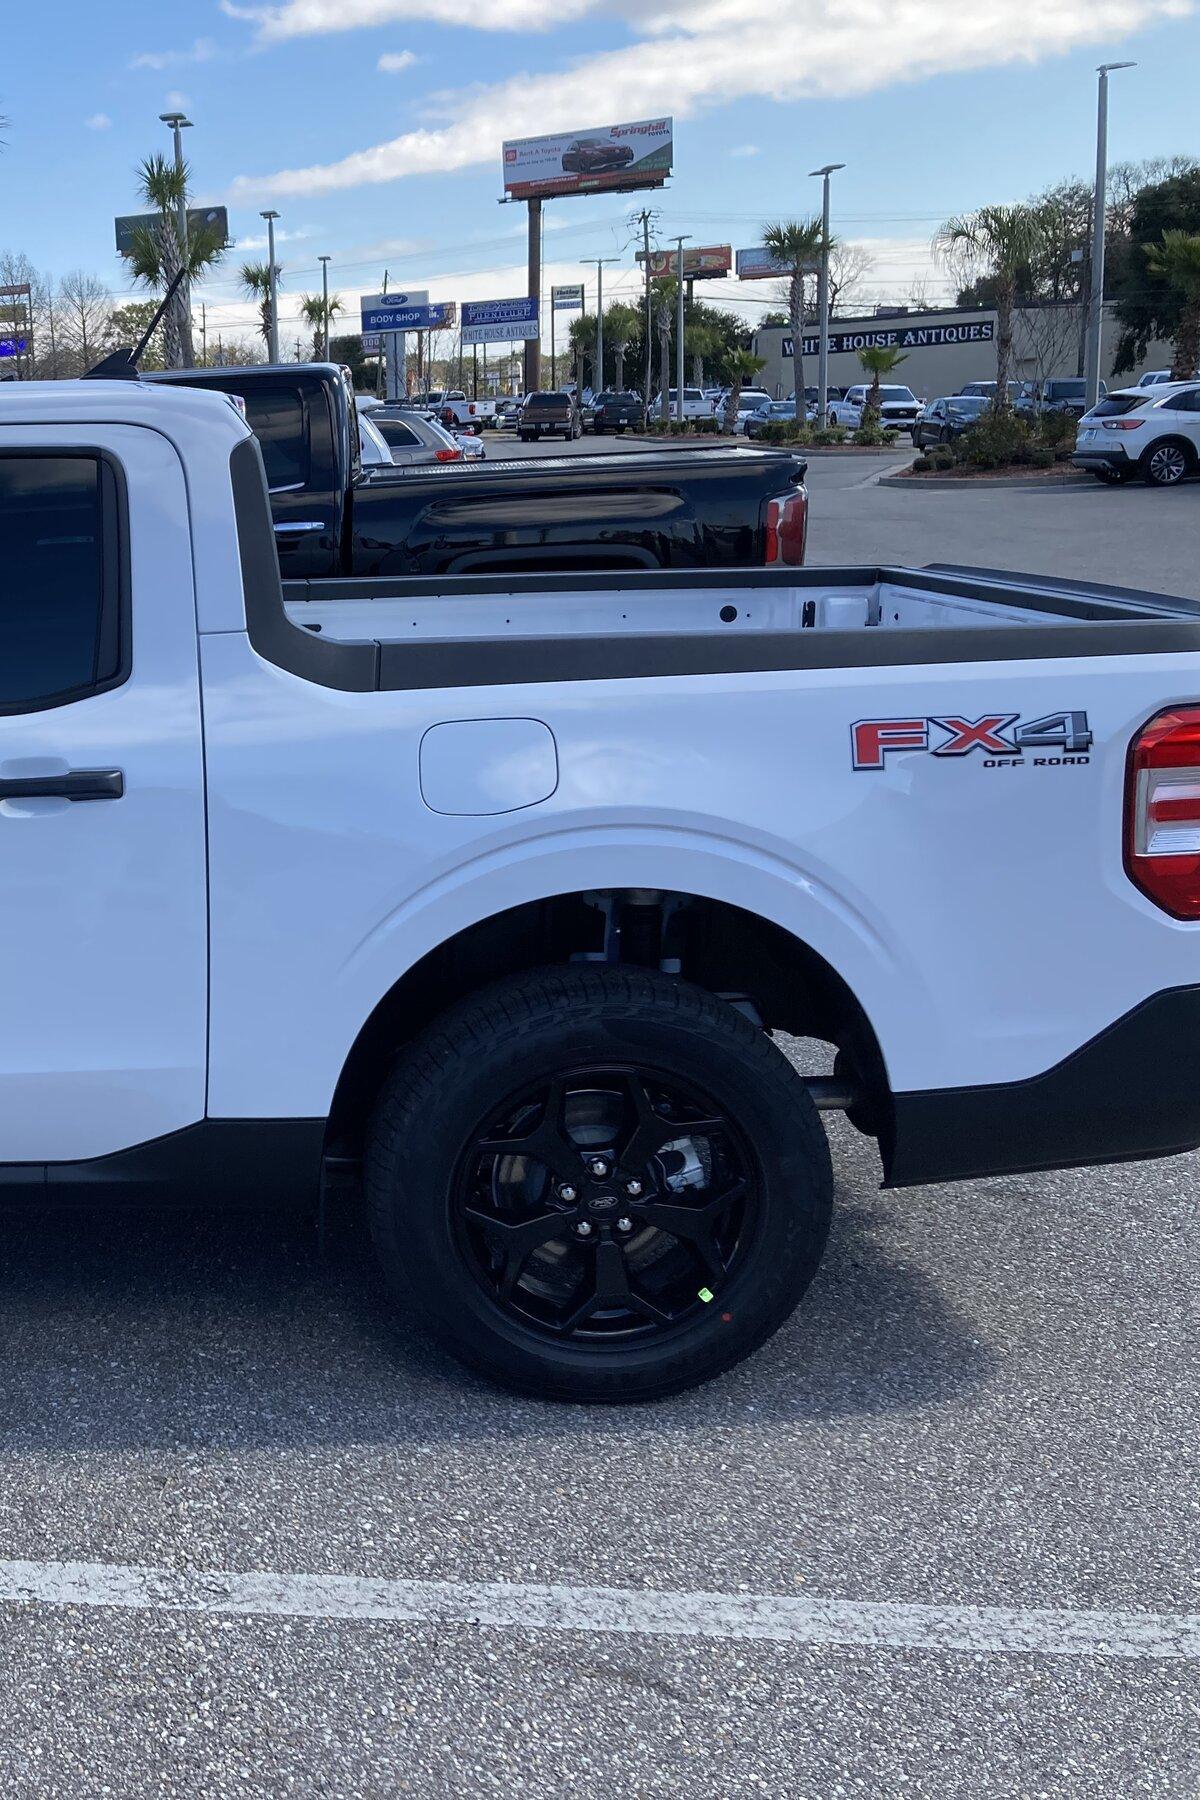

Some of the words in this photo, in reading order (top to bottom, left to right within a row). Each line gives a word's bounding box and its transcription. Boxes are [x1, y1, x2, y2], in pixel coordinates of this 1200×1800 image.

[610, 121, 666, 138] Springhill
[648, 129, 670, 137] TOYOTA
[370, 314, 394, 324] BODY
[396, 312, 420, 322] SHOP
[469, 307, 532, 320] FURNITURE
[463, 329, 483, 341] WHITE
[484, 327, 504, 339] HOUSE
[505, 324, 538, 338] ANTIQUES
[842, 332, 898, 350] HOUSE
[902, 324, 993, 347] ANTIQUES
[850, 711, 1093, 772] FX4
[983, 758, 1025, 768] OFF
[1033, 756, 1090, 767] ROAD
